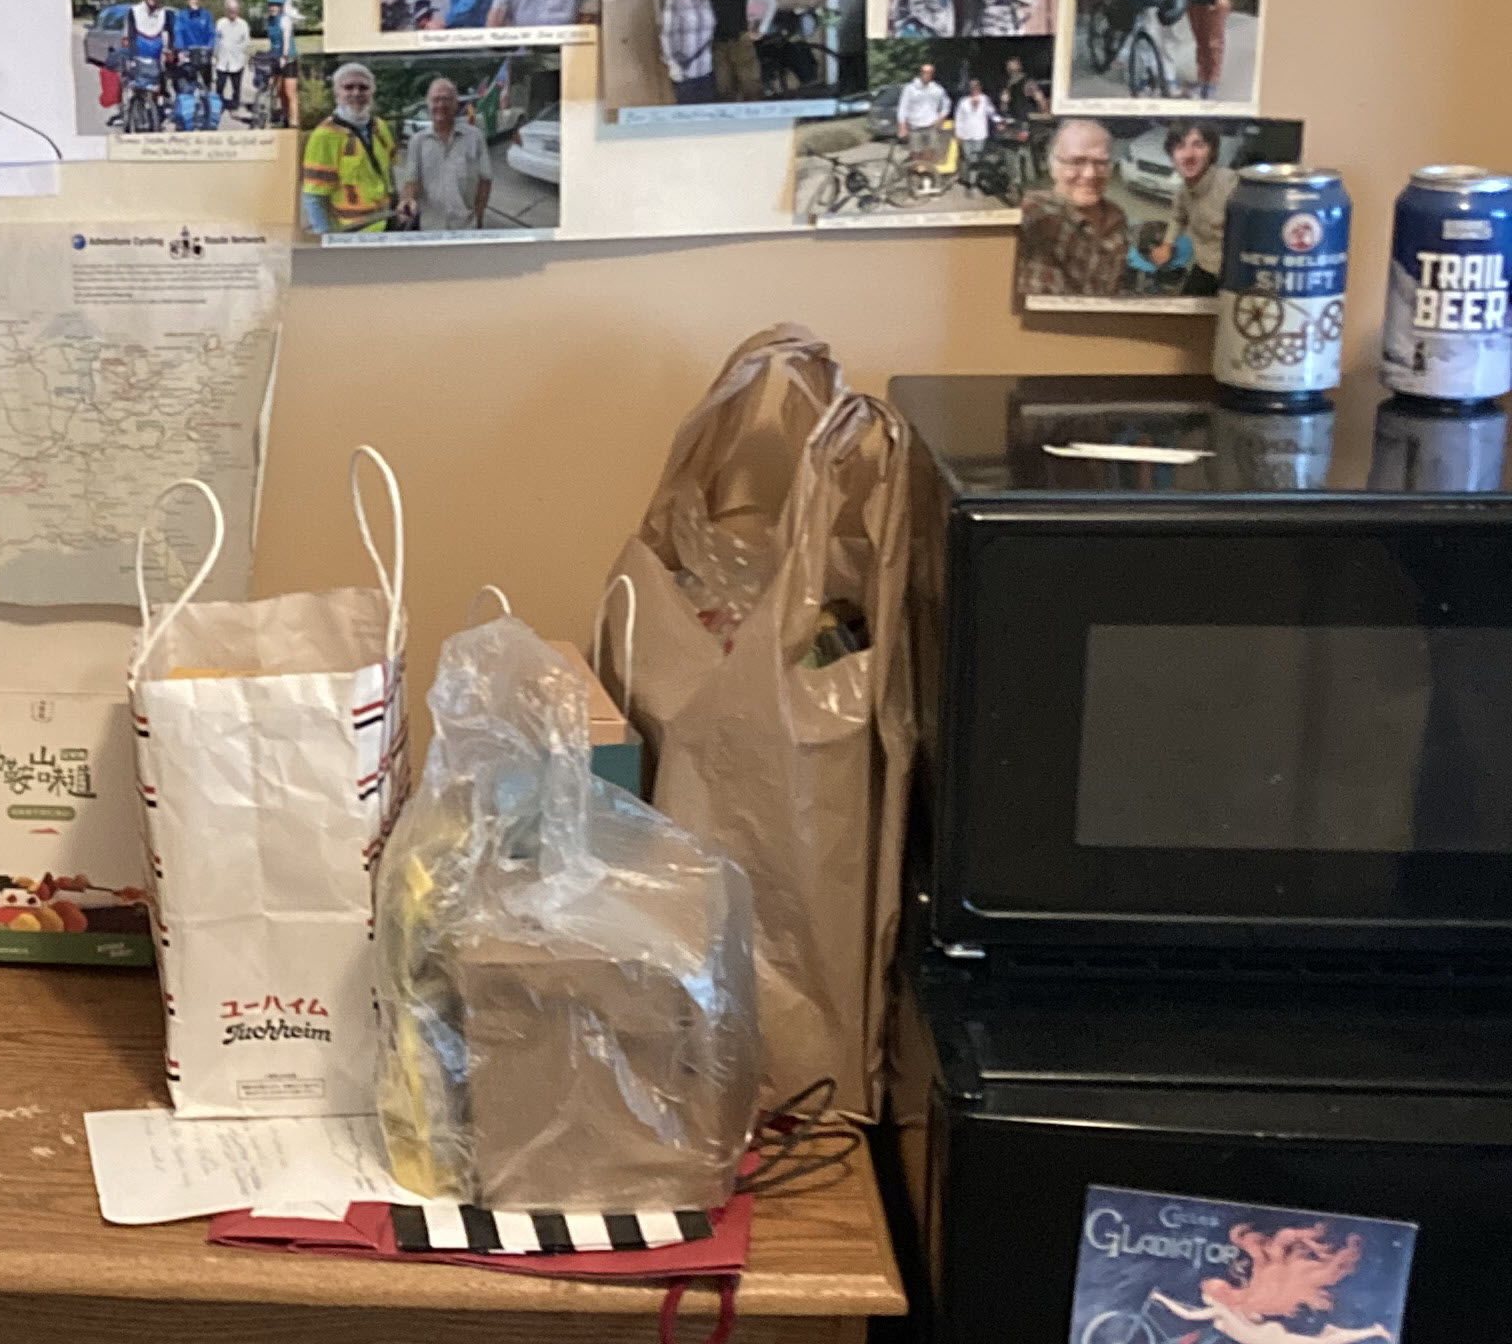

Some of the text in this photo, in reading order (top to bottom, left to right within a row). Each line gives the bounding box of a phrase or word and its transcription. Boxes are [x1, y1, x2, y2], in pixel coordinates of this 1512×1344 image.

[1255, 269, 1337, 293] SHIFT
[1416, 251, 1509, 290] TRAIL
[1413, 288, 1508, 331] BEER
[220, 995, 329, 1018] ユーハイム
[221, 1017, 332, 1045] Juchheim
[1084, 1207, 1241, 1269] GLADIATOR
